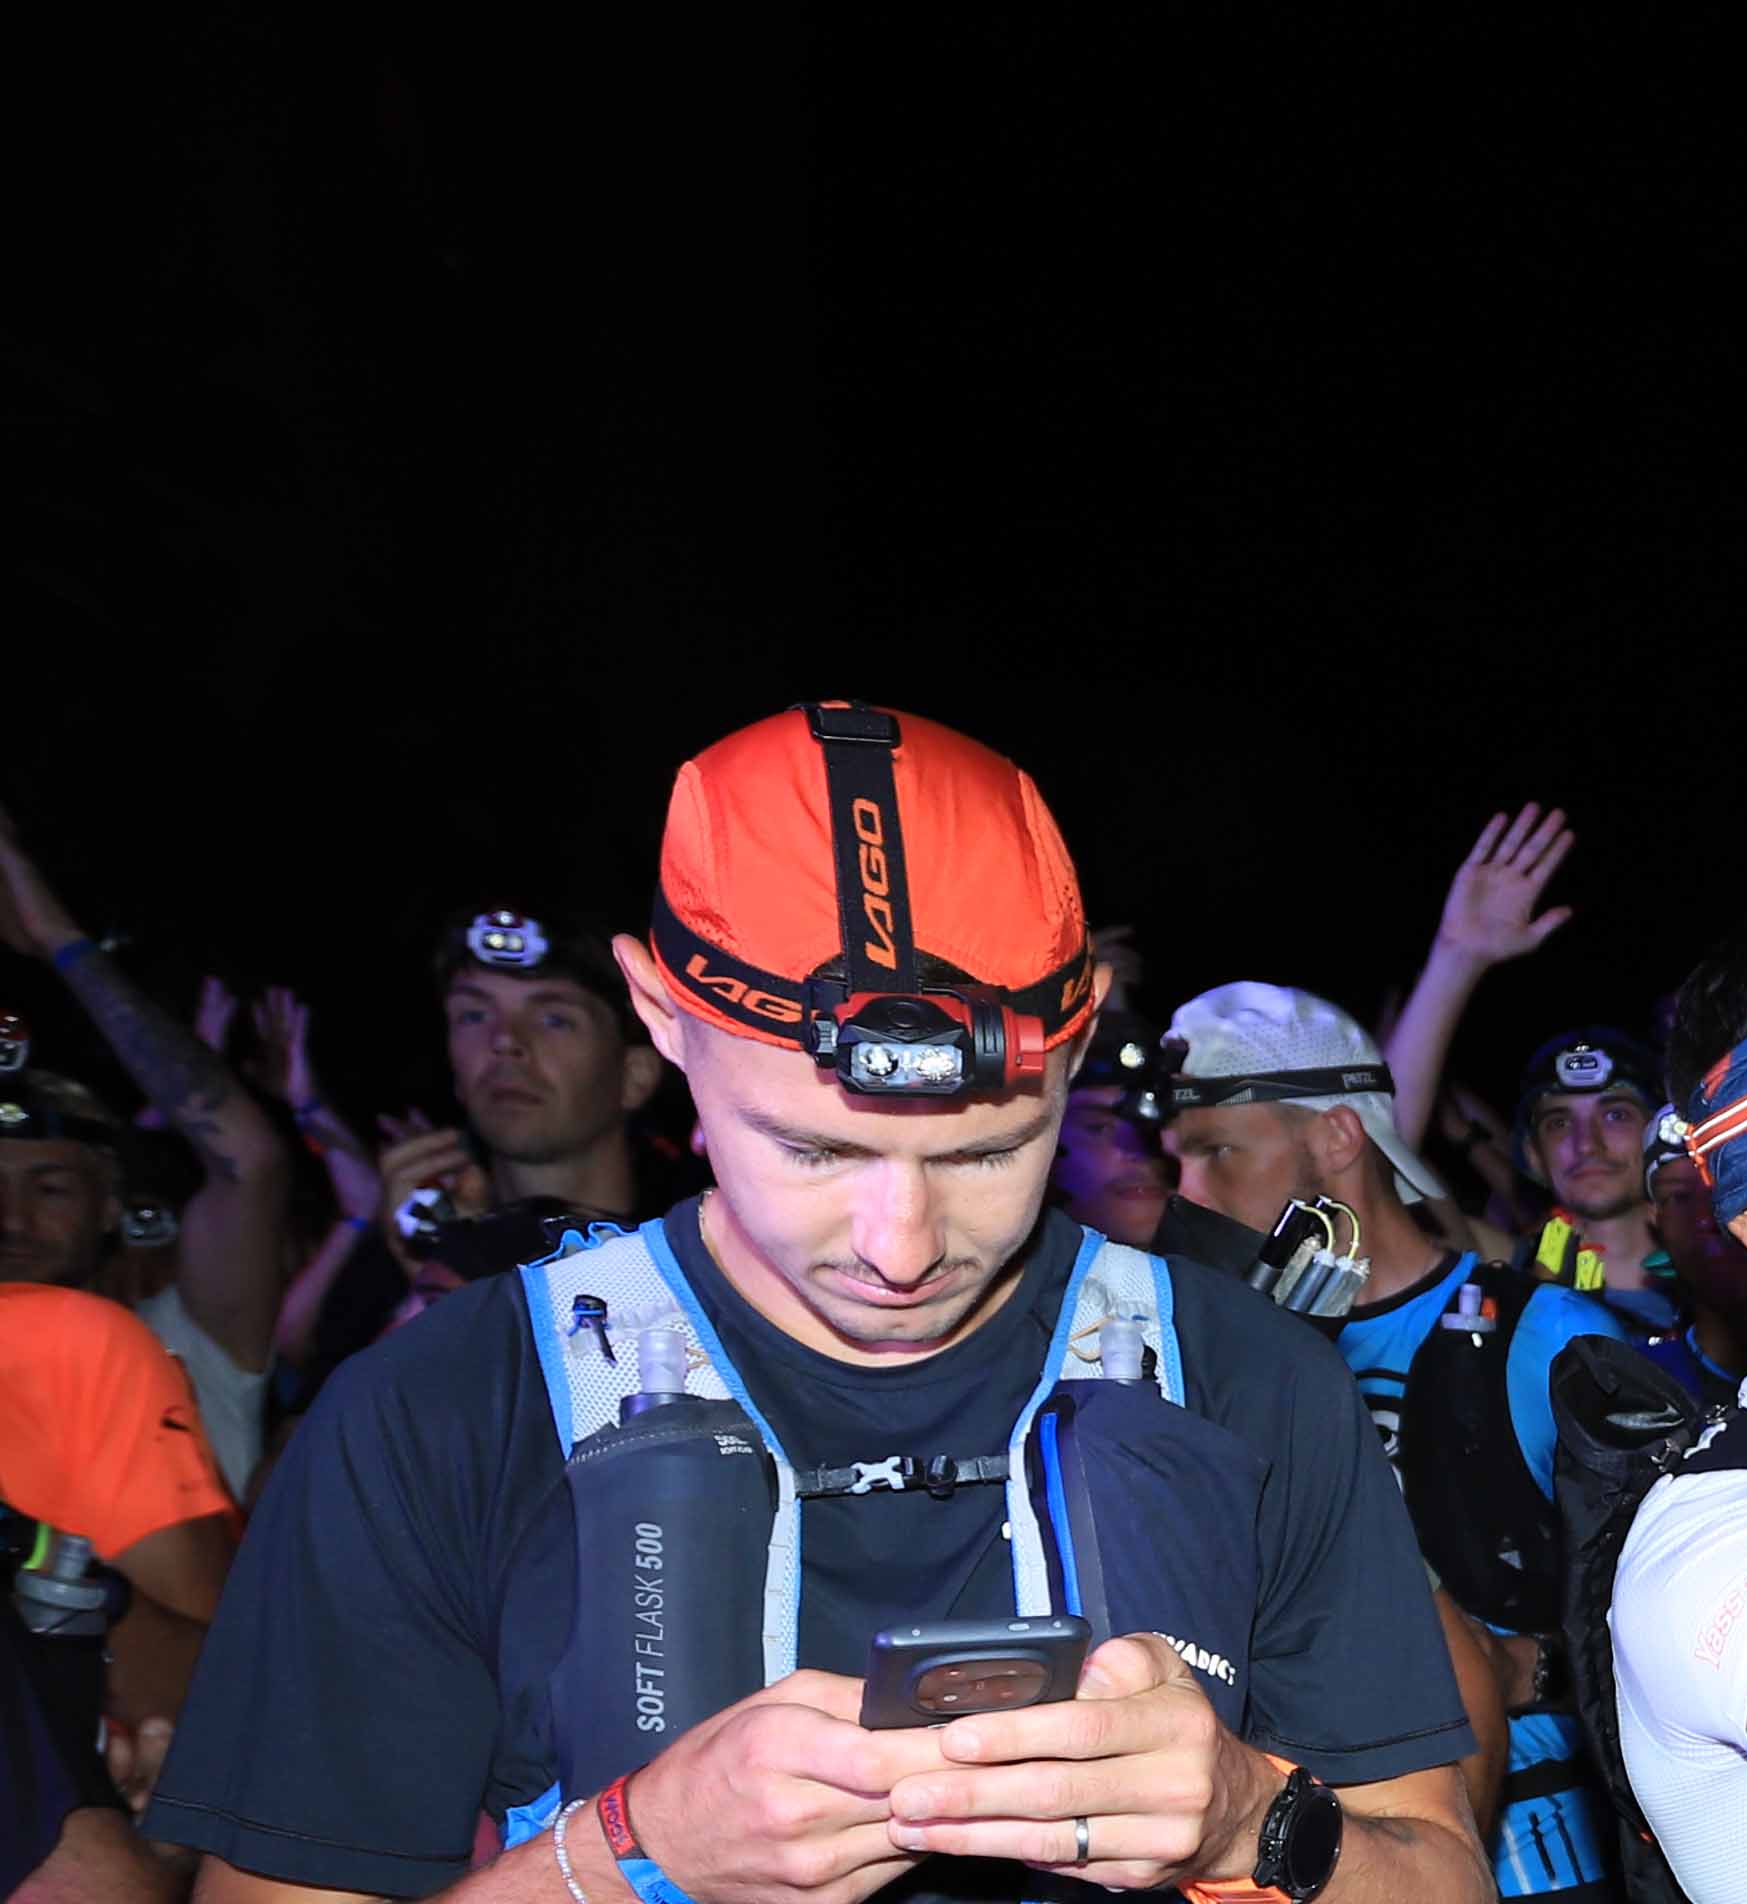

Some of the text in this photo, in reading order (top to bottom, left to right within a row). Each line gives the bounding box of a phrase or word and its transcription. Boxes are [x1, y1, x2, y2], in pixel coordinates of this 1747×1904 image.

[634, 1521, 665, 1733] SOFT FLASK 500
